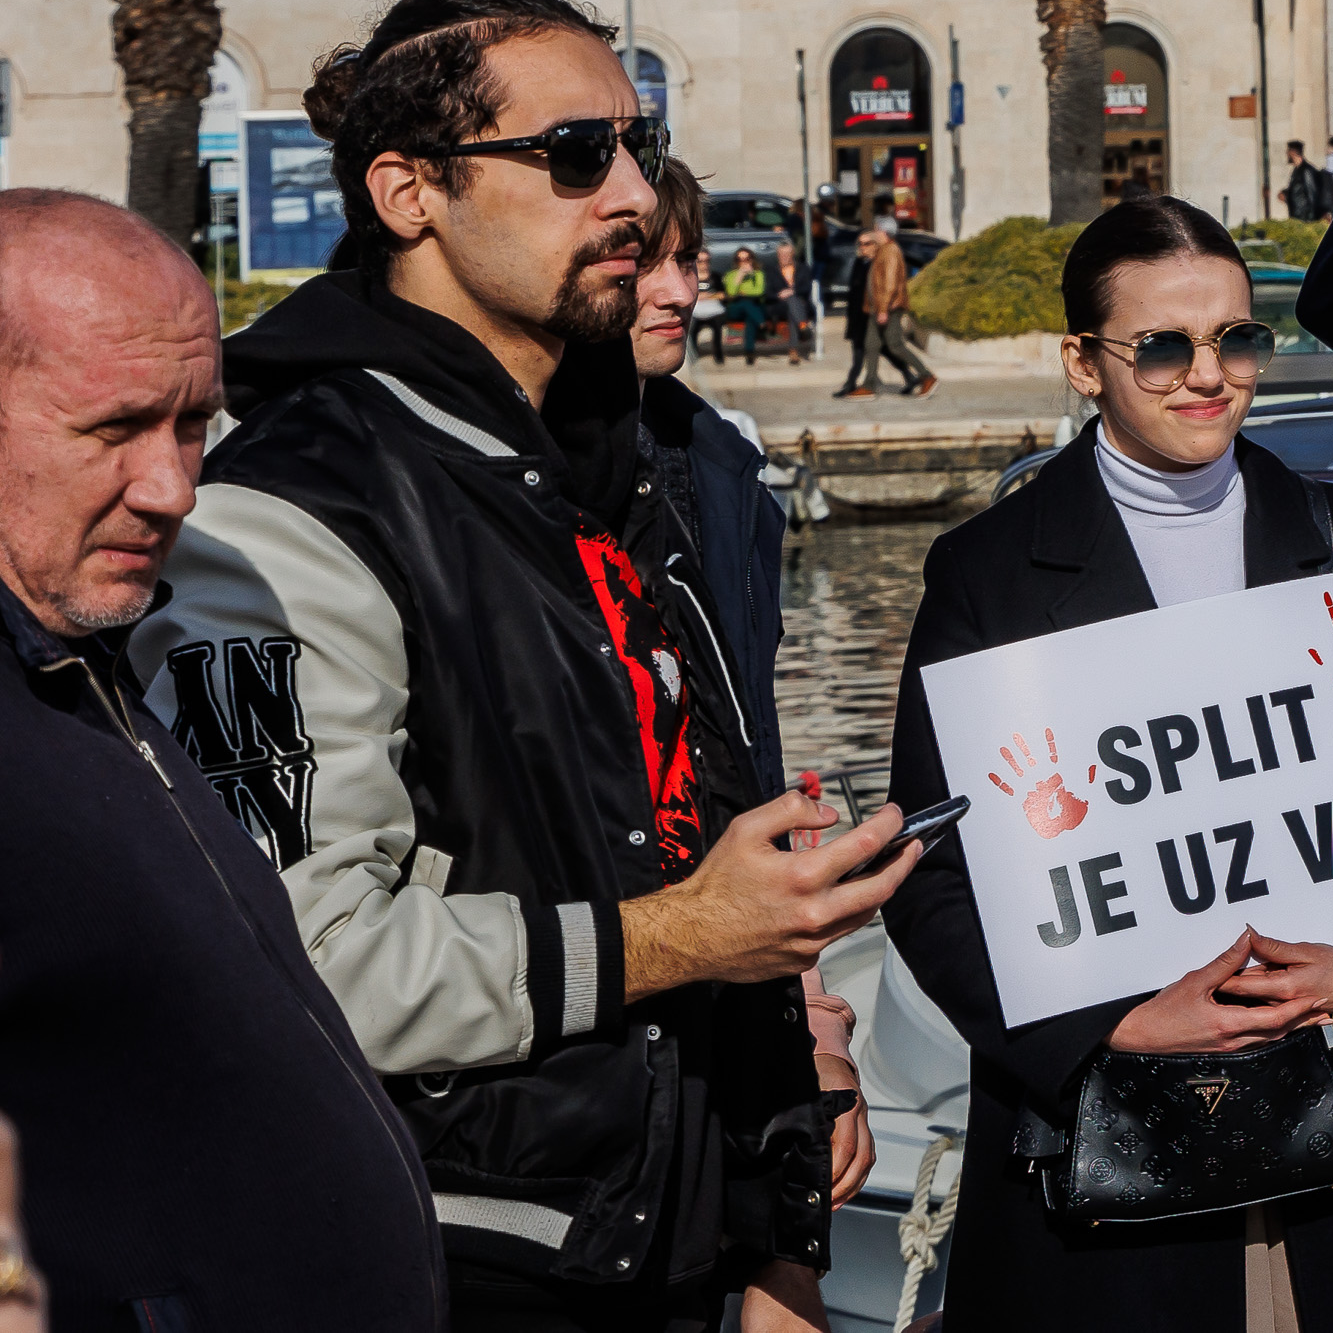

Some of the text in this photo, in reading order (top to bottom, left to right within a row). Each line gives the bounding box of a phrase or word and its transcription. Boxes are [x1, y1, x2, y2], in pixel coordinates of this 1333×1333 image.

[1098, 684, 1316, 805] SPLIT
[1036, 852, 1138, 949] JE
[1156, 820, 1270, 915] UZ
